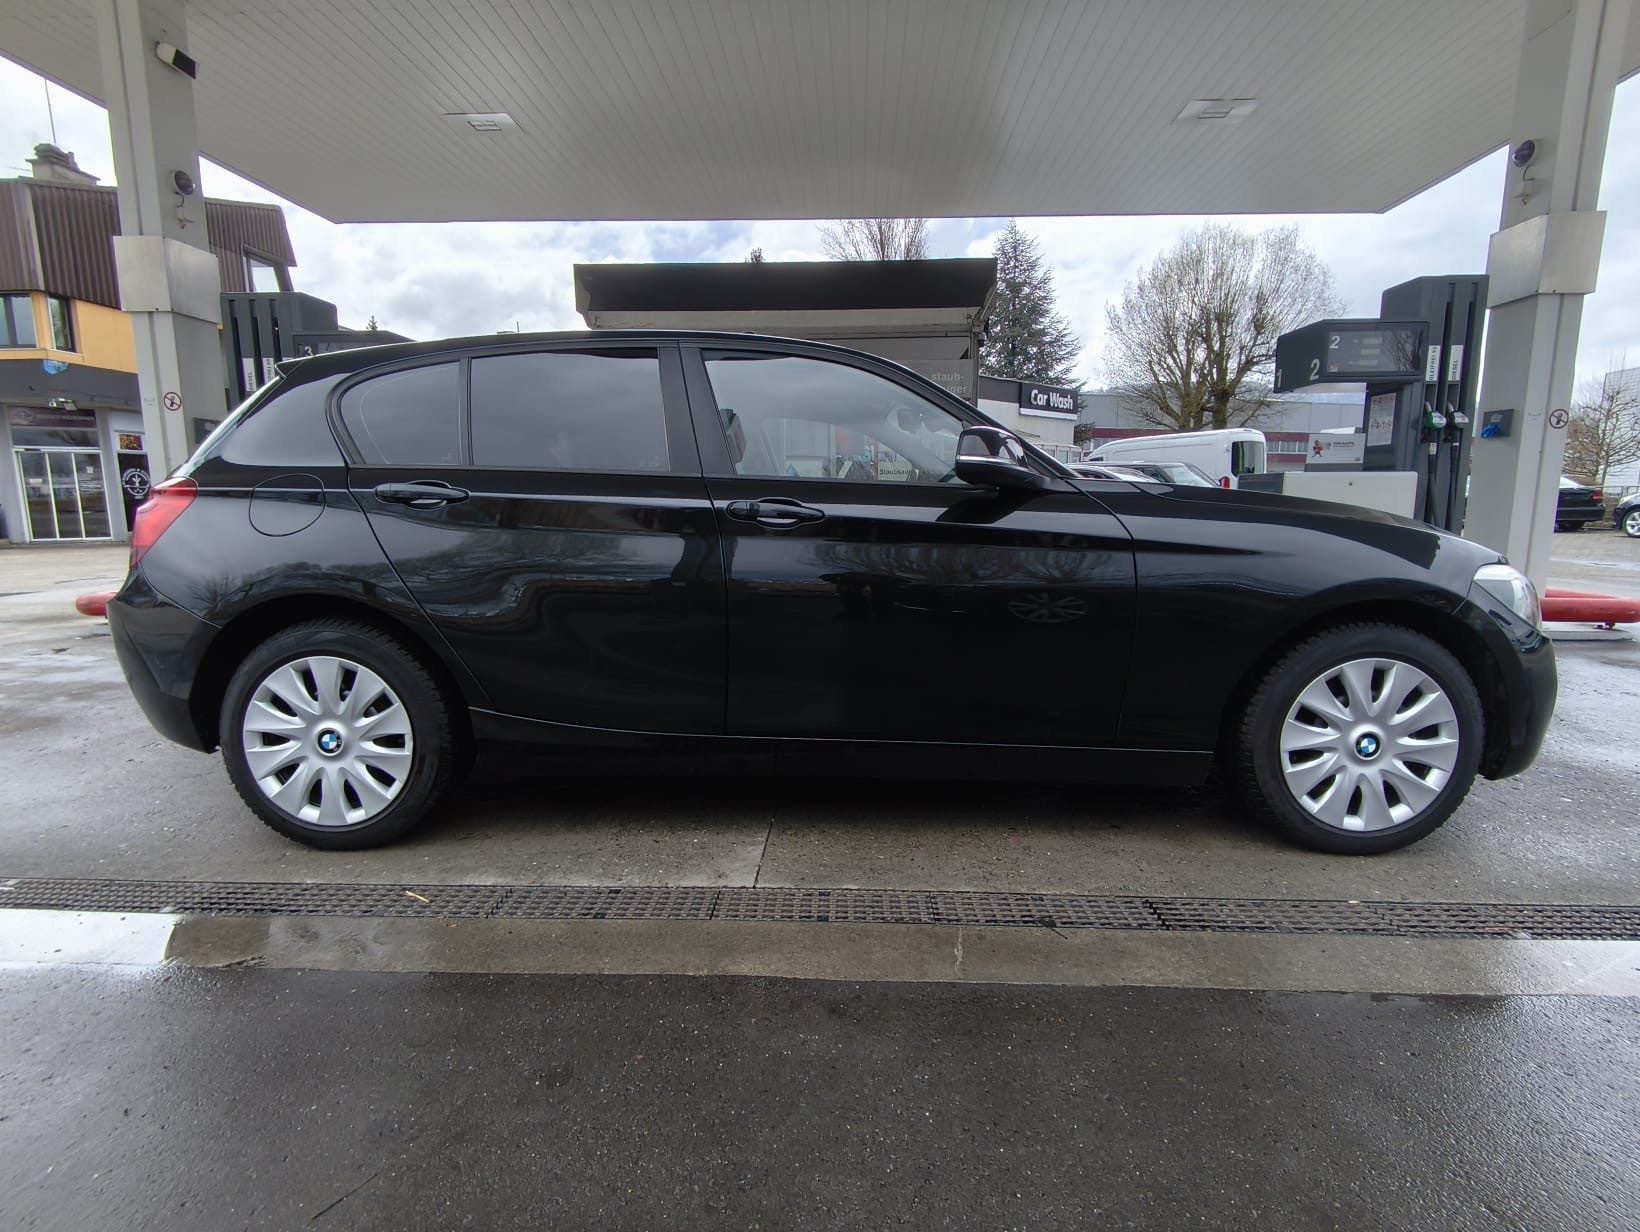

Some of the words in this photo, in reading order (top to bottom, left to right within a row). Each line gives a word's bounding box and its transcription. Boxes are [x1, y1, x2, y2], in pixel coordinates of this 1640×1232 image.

[1329, 335, 1340, 349] 2
[1276, 369, 1282, 388] 1
[1309, 359, 1320, 381] 2
[1451, 360, 1459, 381] DIESEL
[1031, 389, 1048, 405] Car
[1049, 391, 1073, 410] Wash
